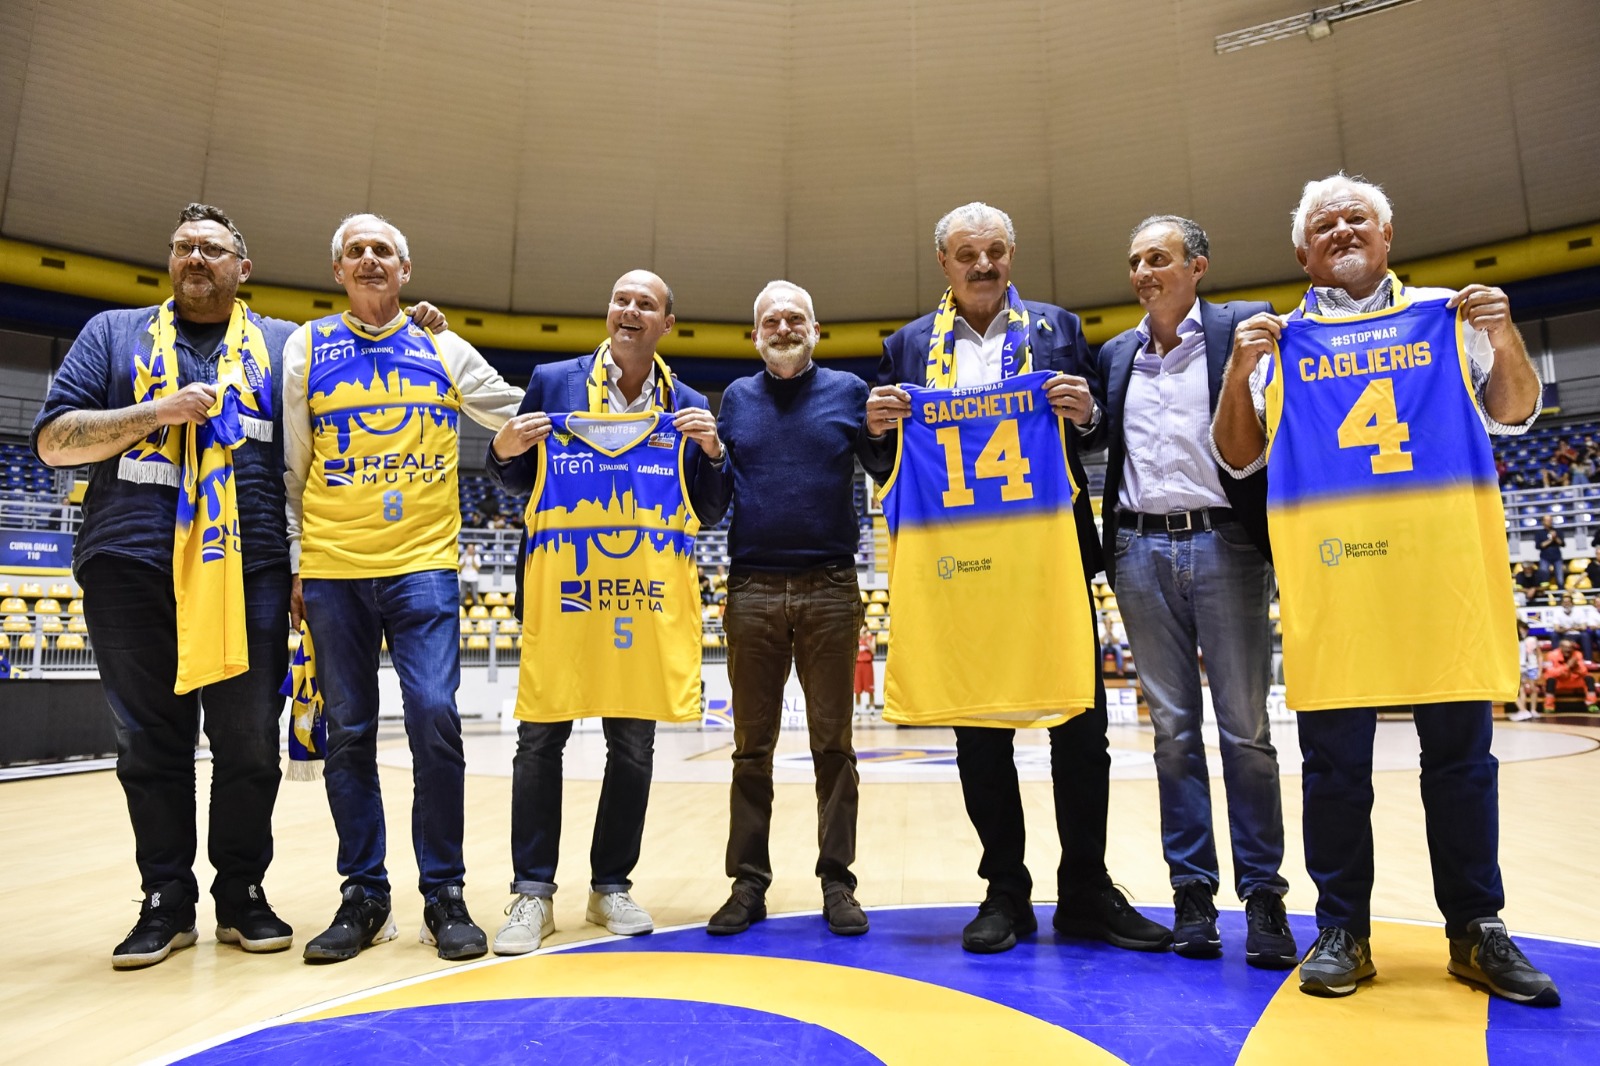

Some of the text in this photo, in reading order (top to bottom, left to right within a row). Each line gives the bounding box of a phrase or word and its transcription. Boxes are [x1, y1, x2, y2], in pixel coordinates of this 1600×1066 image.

[1331, 327, 1398, 347] #STOPWAR
[314, 339, 356, 365] iren
[361, 346, 394, 356] SPALDING
[1003, 341, 1014, 379] TUA
[1298, 341, 1432, 382] CAGLIERIS
[951, 382, 1004, 397] #STOPWAR
[923, 390, 1034, 424] SACCHETTI
[1337, 378, 1413, 475] 4
[363, 453, 446, 470] REALE
[552, 452, 594, 475] iren
[598, 463, 629, 472] SPALDING
[637, 464, 674, 476] LAVAZZA
[935, 418, 1034, 508] 14
[361, 472, 446, 484] MUTUA
[382, 489, 403, 522] 8
[9, 541, 59, 552] CURVA GIALLA
[1344, 540, 1389, 551] Banca del
[1345, 548, 1388, 559] Piemonte
[957, 564, 992, 573] Piemonte
[980, 557, 992, 565] del
[598, 578, 665, 598] REAE
[613, 616, 633, 649] 5
